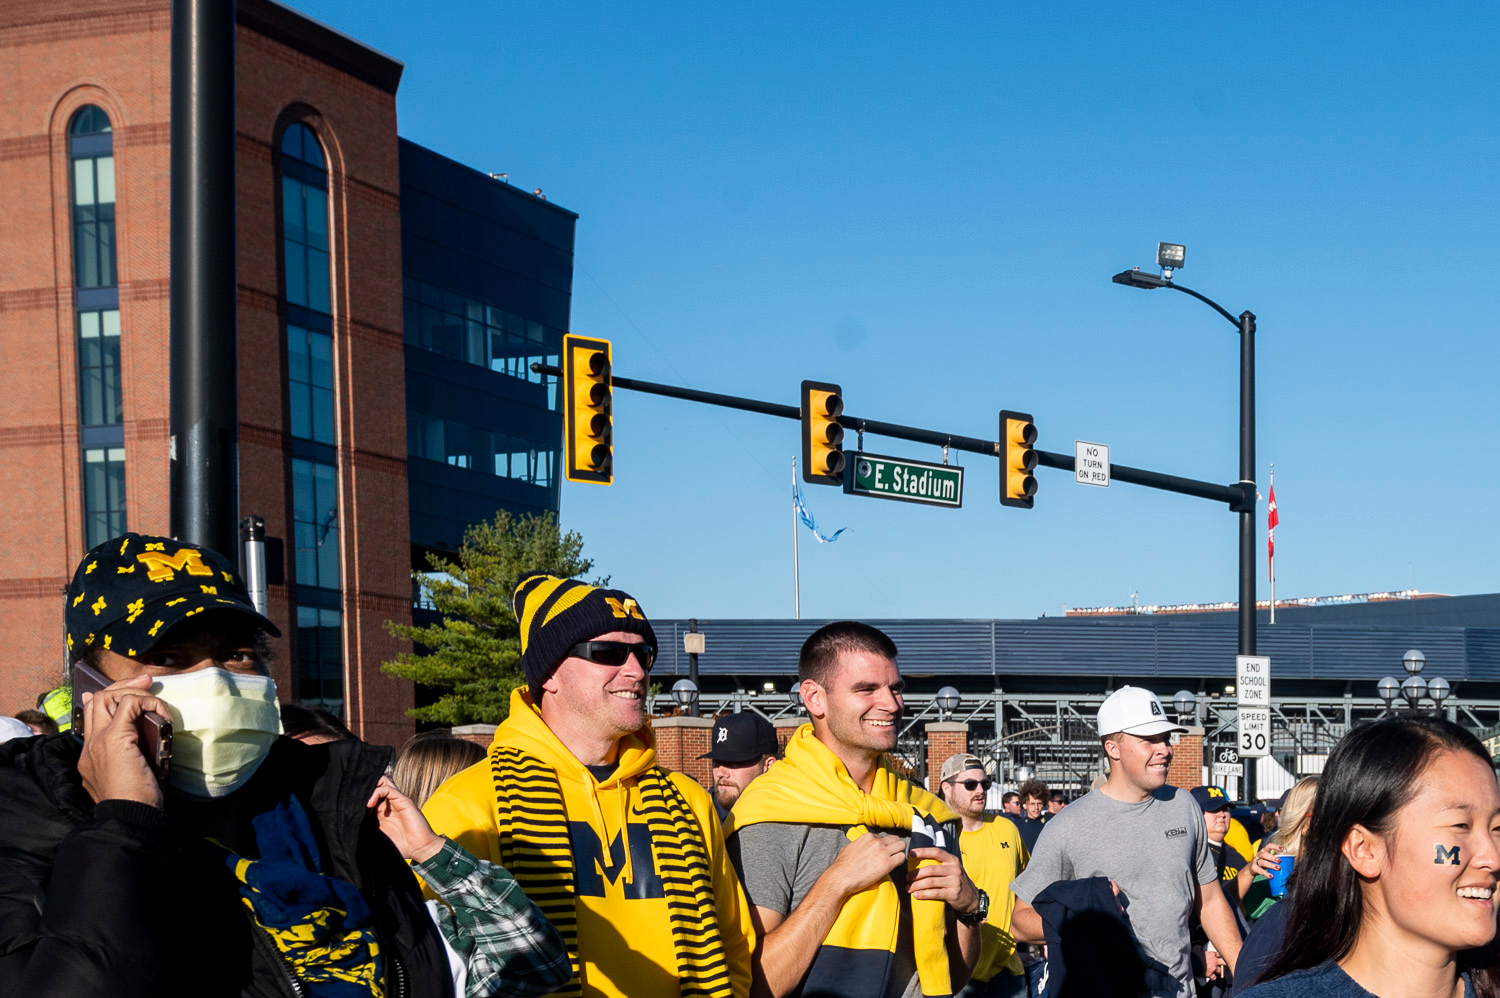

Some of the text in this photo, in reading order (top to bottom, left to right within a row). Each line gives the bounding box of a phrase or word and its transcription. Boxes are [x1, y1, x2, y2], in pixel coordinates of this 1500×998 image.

[1086, 447, 1099, 457] NO
[1083, 459, 1102, 469] TURN
[1078, 470, 1106, 481] ON RED
[874, 463, 955, 499] E. Stadium
[136, 548, 214, 581] M
[604, 597, 645, 620] M
[1246, 663, 1260, 672] END
[1240, 676, 1267, 686] SCHOOL
[1244, 690, 1263, 699] ZONE
[1240, 713, 1267, 721] SPEED
[1243, 723, 1264, 731] LIMIT
[1242, 733, 1266, 750] 30
[1214, 764, 1242, 774] BIKE LANE
[1207, 787, 1223, 798] M
[568, 820, 667, 900] M
[1433, 844, 1461, 866] M
